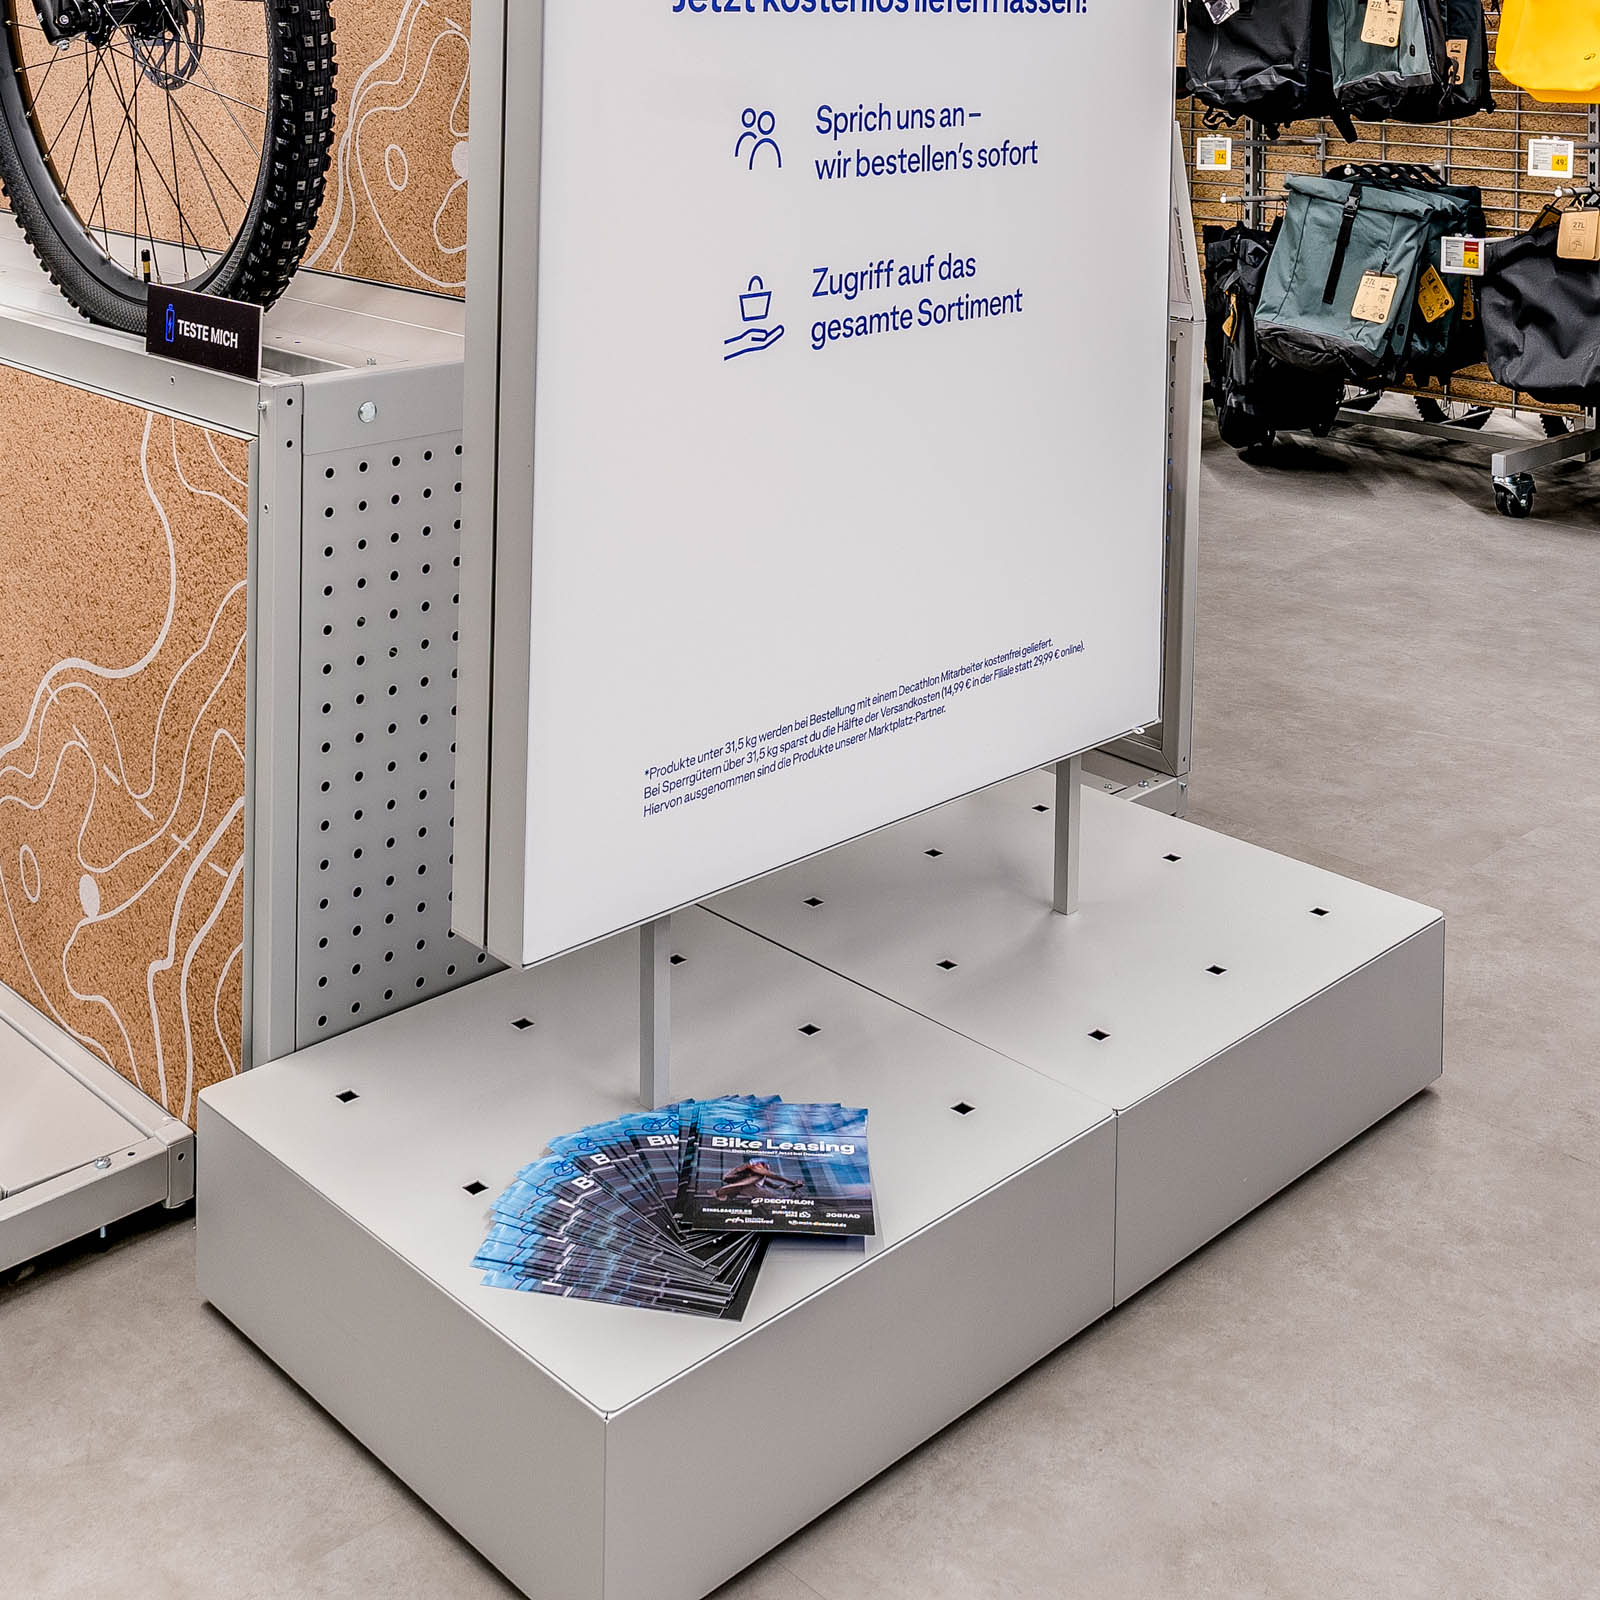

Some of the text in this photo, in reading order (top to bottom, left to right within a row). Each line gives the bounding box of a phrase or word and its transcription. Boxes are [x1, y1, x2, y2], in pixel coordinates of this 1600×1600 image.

[816, 103, 891, 139] Sprich
[897, 109, 935, 130] uns
[940, 107, 964, 127] an
[815, 151, 851, 179] wir
[978, 140, 1037, 168] sofort
[812, 253, 975, 300] Zugriff auf das
[178, 319, 238, 349] TESTE MICH
[811, 288, 1022, 350] gesamte Sortiment
[698, 747, 723, 763] unter
[725, 737, 744, 754] 31,5
[746, 736, 757, 748] kg
[759, 725, 793, 742] werden
[795, 717, 808, 730] bei
[810, 704, 855, 726] Bestellung
[857, 697, 871, 710] mit
[872, 690, 897, 704] einem
[899, 677, 939, 696] Decathlon
[941, 661, 983, 682] Mitarbeiter
[984, 647, 1021, 667] kostenfrei
[1022, 639, 1053, 658] geliefert.
[644, 783, 660, 799] Bei
[662, 766, 721, 793] Sperrgütern
[723, 757, 745, 771] über
[747, 747, 765, 763] 31,5
[767, 746, 778, 757] kg
[780, 735, 808, 753] sparst
[810, 730, 821, 742] du
[823, 725, 836, 738] die
[837, 717, 863, 733] Hälfte
[865, 712, 879, 723] der
[881, 692, 940, 717] Versandkosten
[973, 677, 979, 687] in
[981, 674, 993, 684] der
[994, 665, 1014, 680] Filiale
[1015, 660, 1032, 673] statt
[1034, 651, 1053, 666] 29,99
[644, 706, 946, 817] Hiervon ausgenommen sind die Produkte unserer Marktplatz-Partner.
[647, 1134, 679, 1146] Bik
[711, 1136, 855, 1155] Bike Leasing
[763, 1198, 815, 1206] DECATHLON
